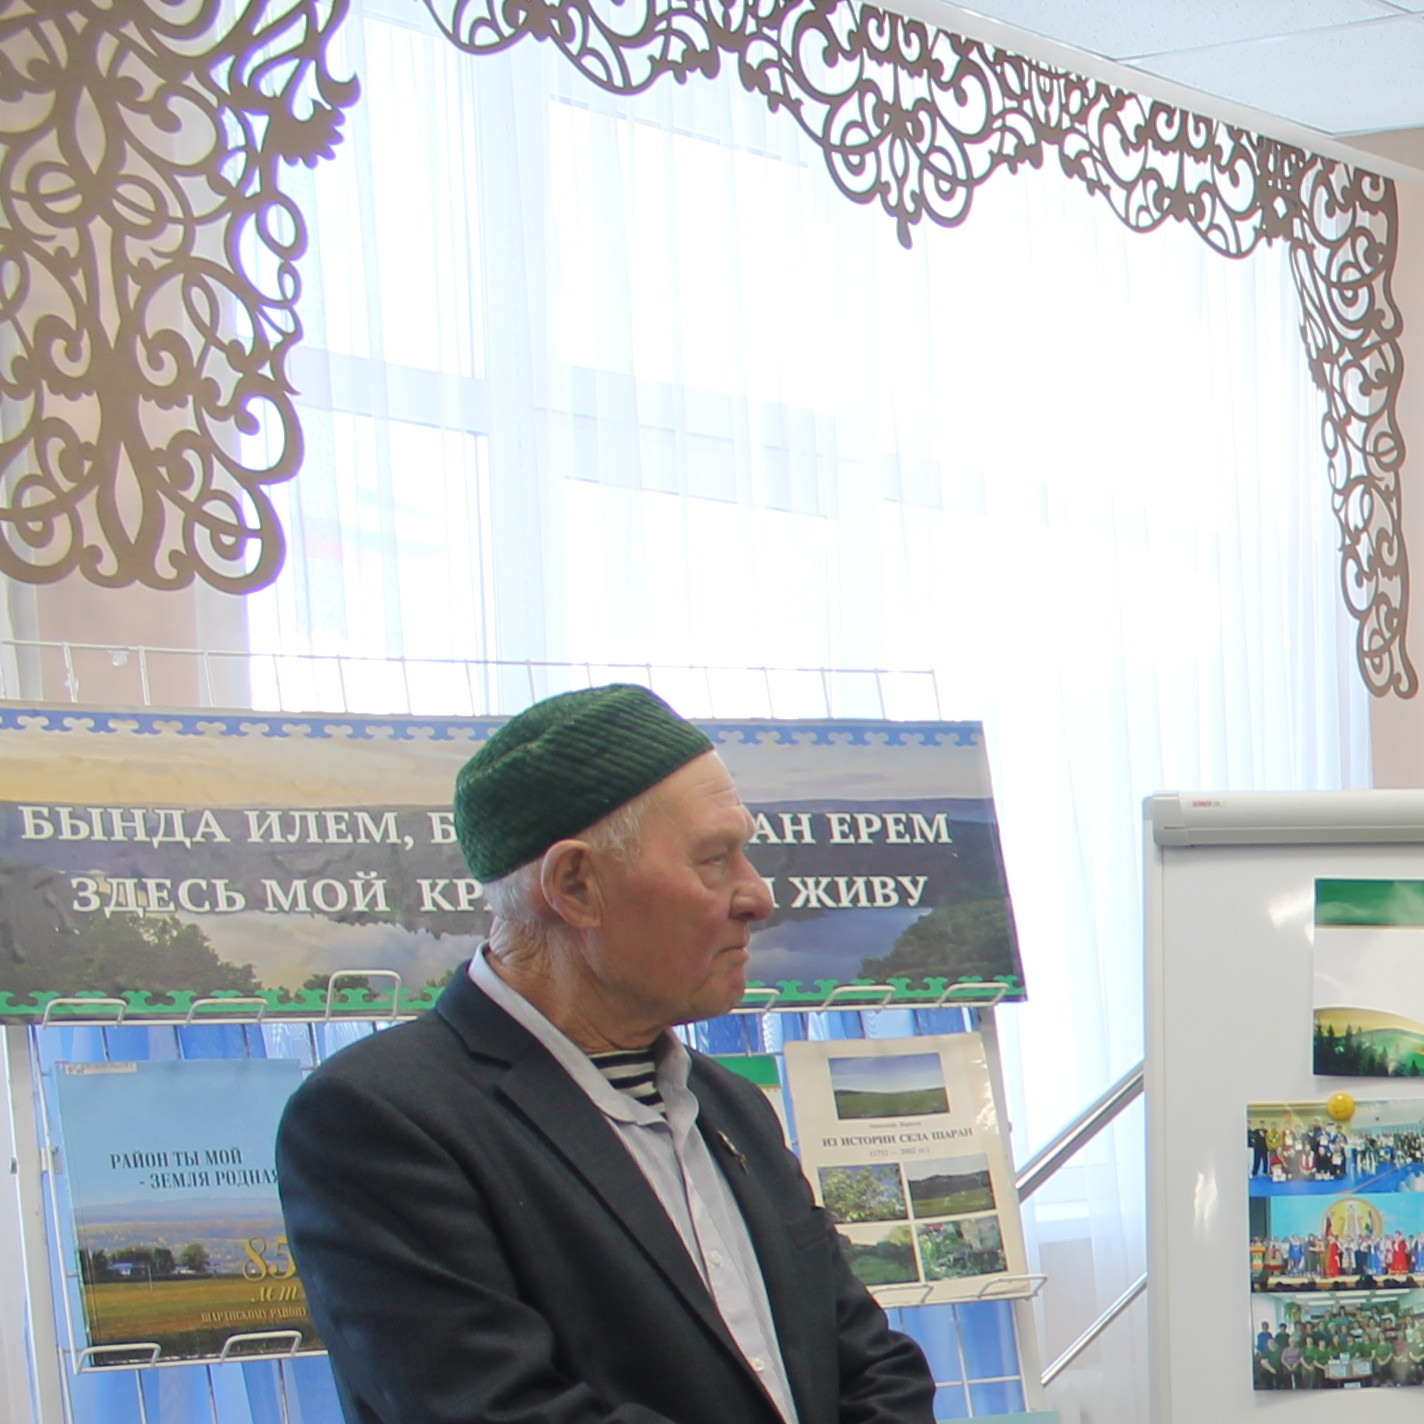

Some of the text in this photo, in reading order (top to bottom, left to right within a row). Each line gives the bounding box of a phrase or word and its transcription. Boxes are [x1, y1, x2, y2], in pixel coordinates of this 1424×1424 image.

[17, 805, 231, 849] БЫНДА
[245, 810, 414, 850] ИЛЕМ,
[828, 812, 952, 844] ЕРЕМ
[71, 876, 246, 918] ЗДЕСЬ
[261, 871, 391, 912] МОЙ
[787, 875, 929, 909] ЖИВУ
[822, 1127, 973, 1148] ИЗ ИСТОРИИ СЕЛА ШАРАН
[110, 1147, 243, 1170] РАЙОН ТЫ МОЙ
[150, 1171, 210, 1189] ЗЕМЛЯ
[242, 1235, 297, 1281] 85
[201, 1309, 267, 1323] ШАРАНСКОМУ
